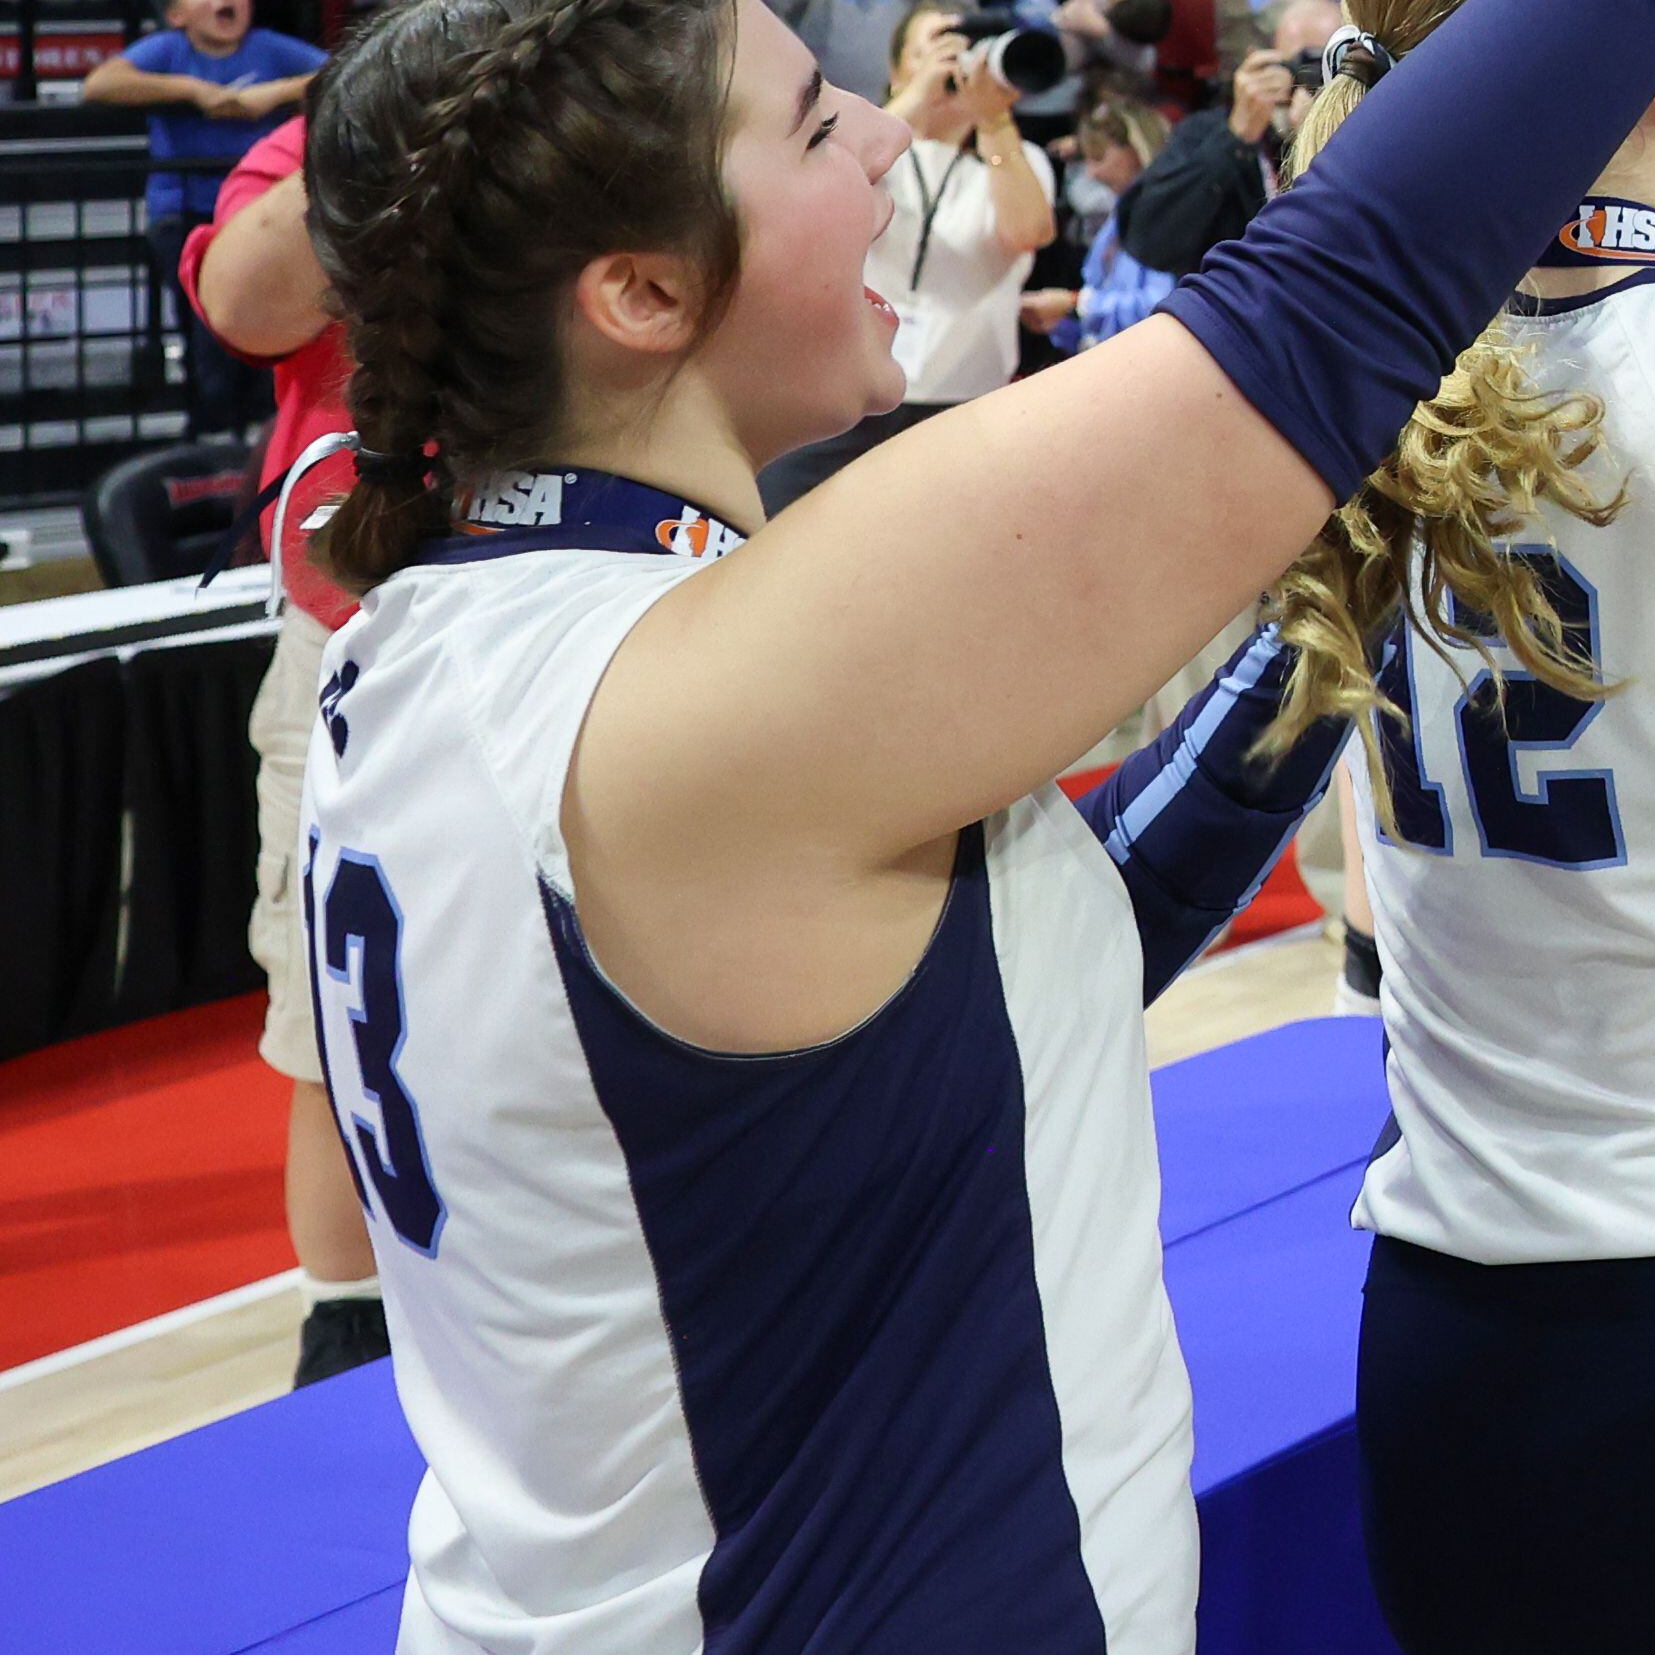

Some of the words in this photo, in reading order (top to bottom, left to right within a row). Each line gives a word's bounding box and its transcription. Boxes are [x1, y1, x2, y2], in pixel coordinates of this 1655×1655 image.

[463, 470, 563, 527] HSA
[1374, 544, 1628, 871] 12
[301, 824, 448, 1261] 13
